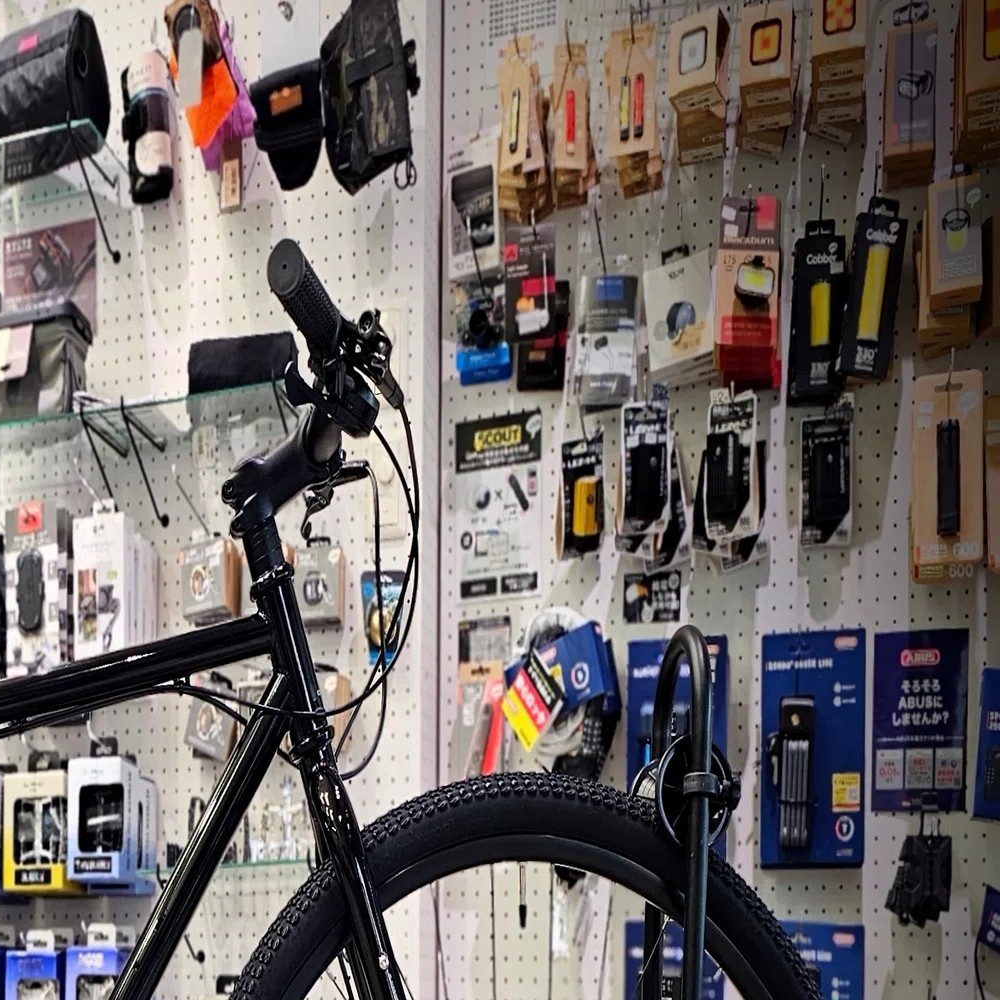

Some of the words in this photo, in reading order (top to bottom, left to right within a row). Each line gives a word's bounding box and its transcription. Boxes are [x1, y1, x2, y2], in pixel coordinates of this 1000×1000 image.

[866, 228, 898, 244] Cobber
[806, 253, 838, 266] Cobber
[477, 424, 522, 445] SCOUT
[901, 679, 941, 694] そろそろ
[898, 695, 943, 710] ABUSに
[892, 711, 949, 727] しませんか?
